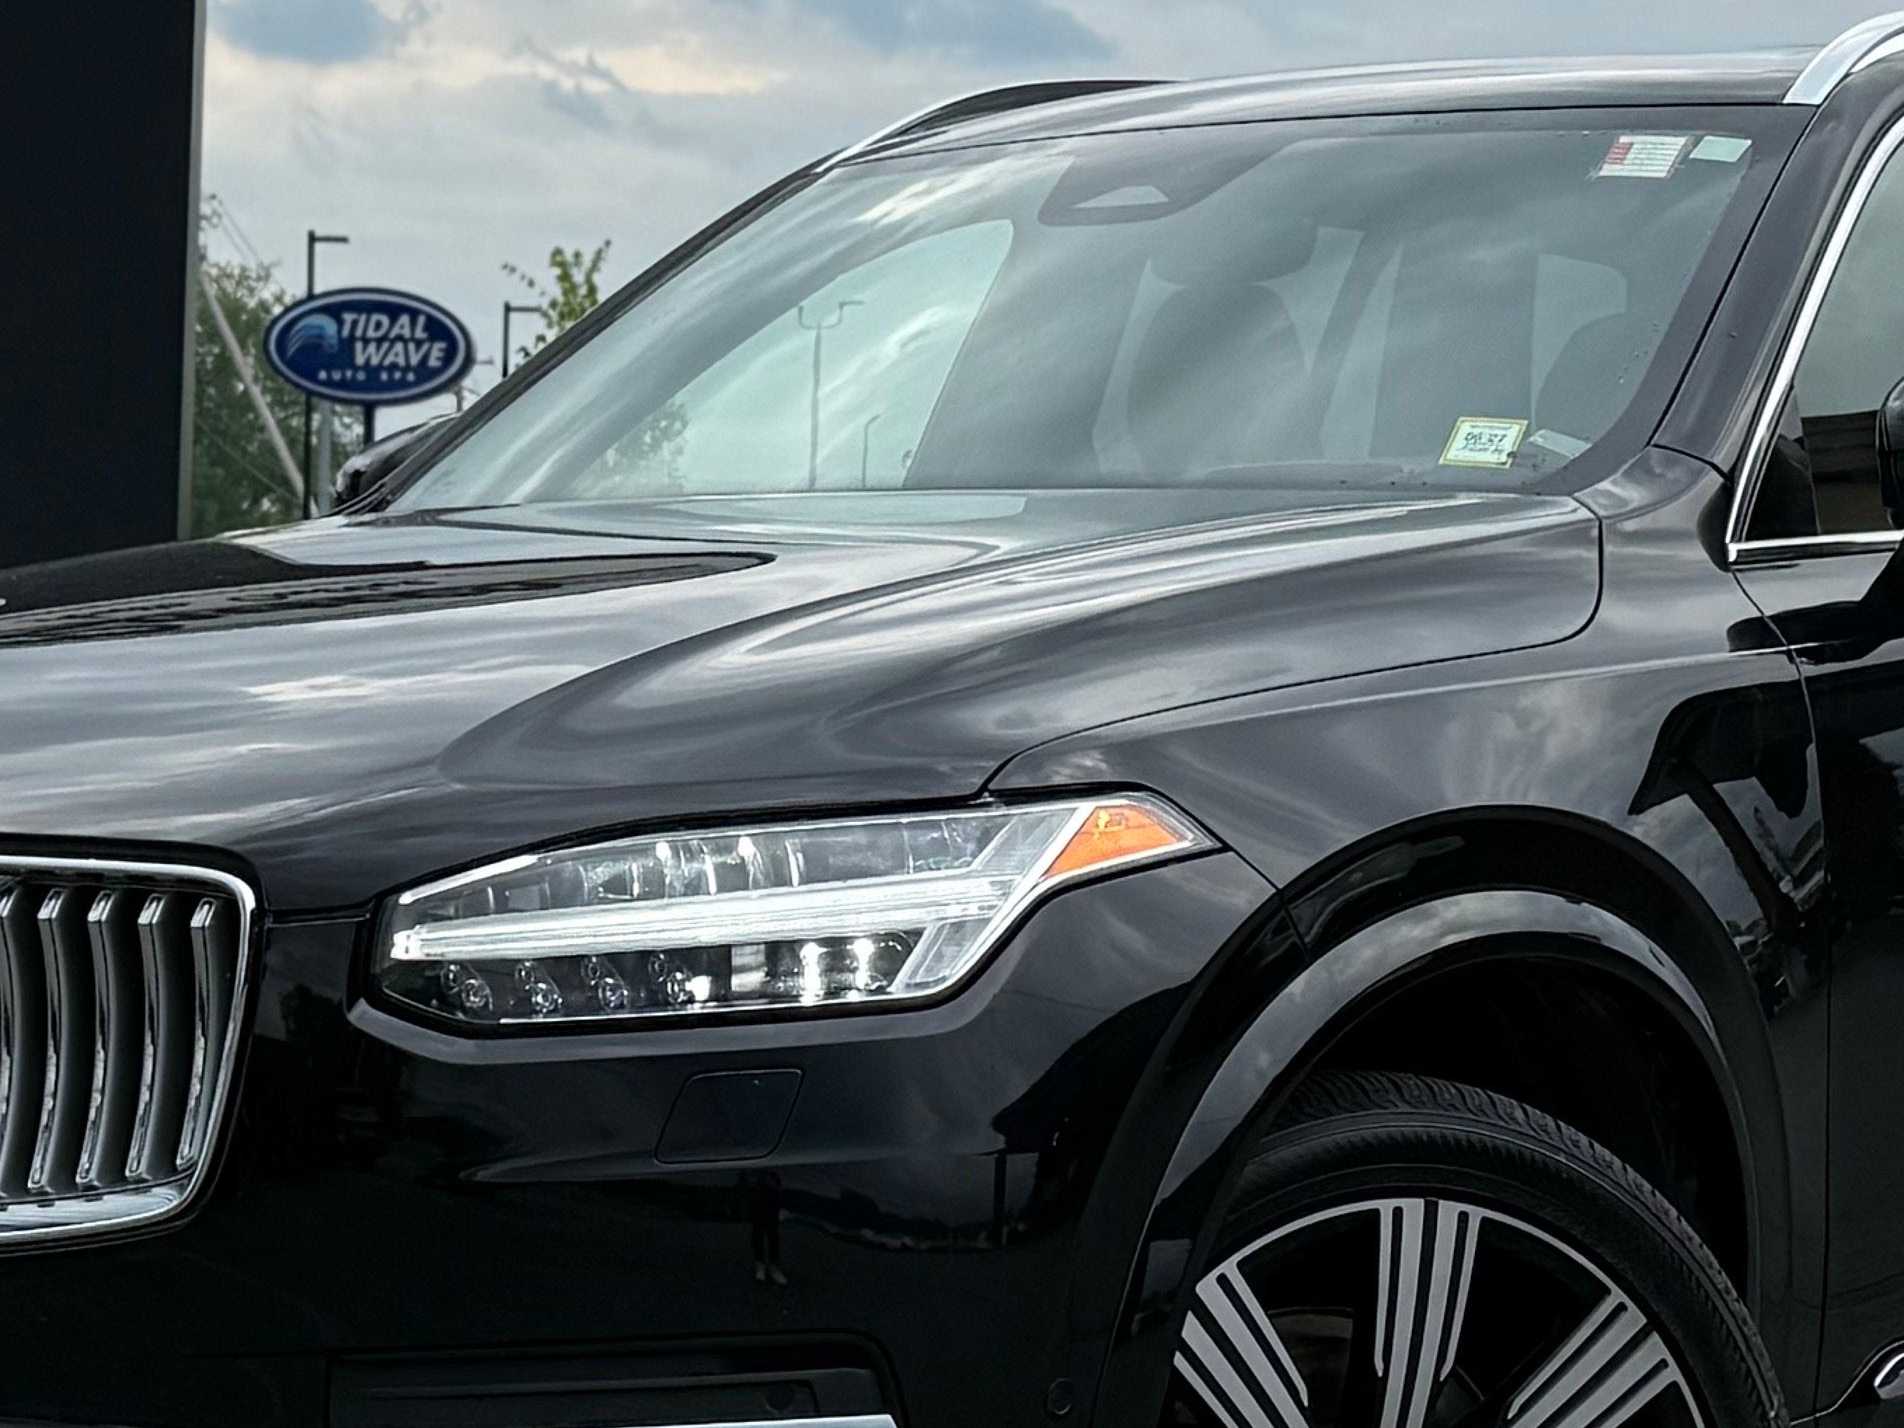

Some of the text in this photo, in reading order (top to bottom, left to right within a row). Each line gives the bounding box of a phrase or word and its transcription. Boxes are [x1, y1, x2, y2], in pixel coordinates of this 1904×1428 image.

[340, 311, 429, 339] TIDAL
[353, 340, 447, 368] WAVE
[317, 369, 367, 381] AUTO
